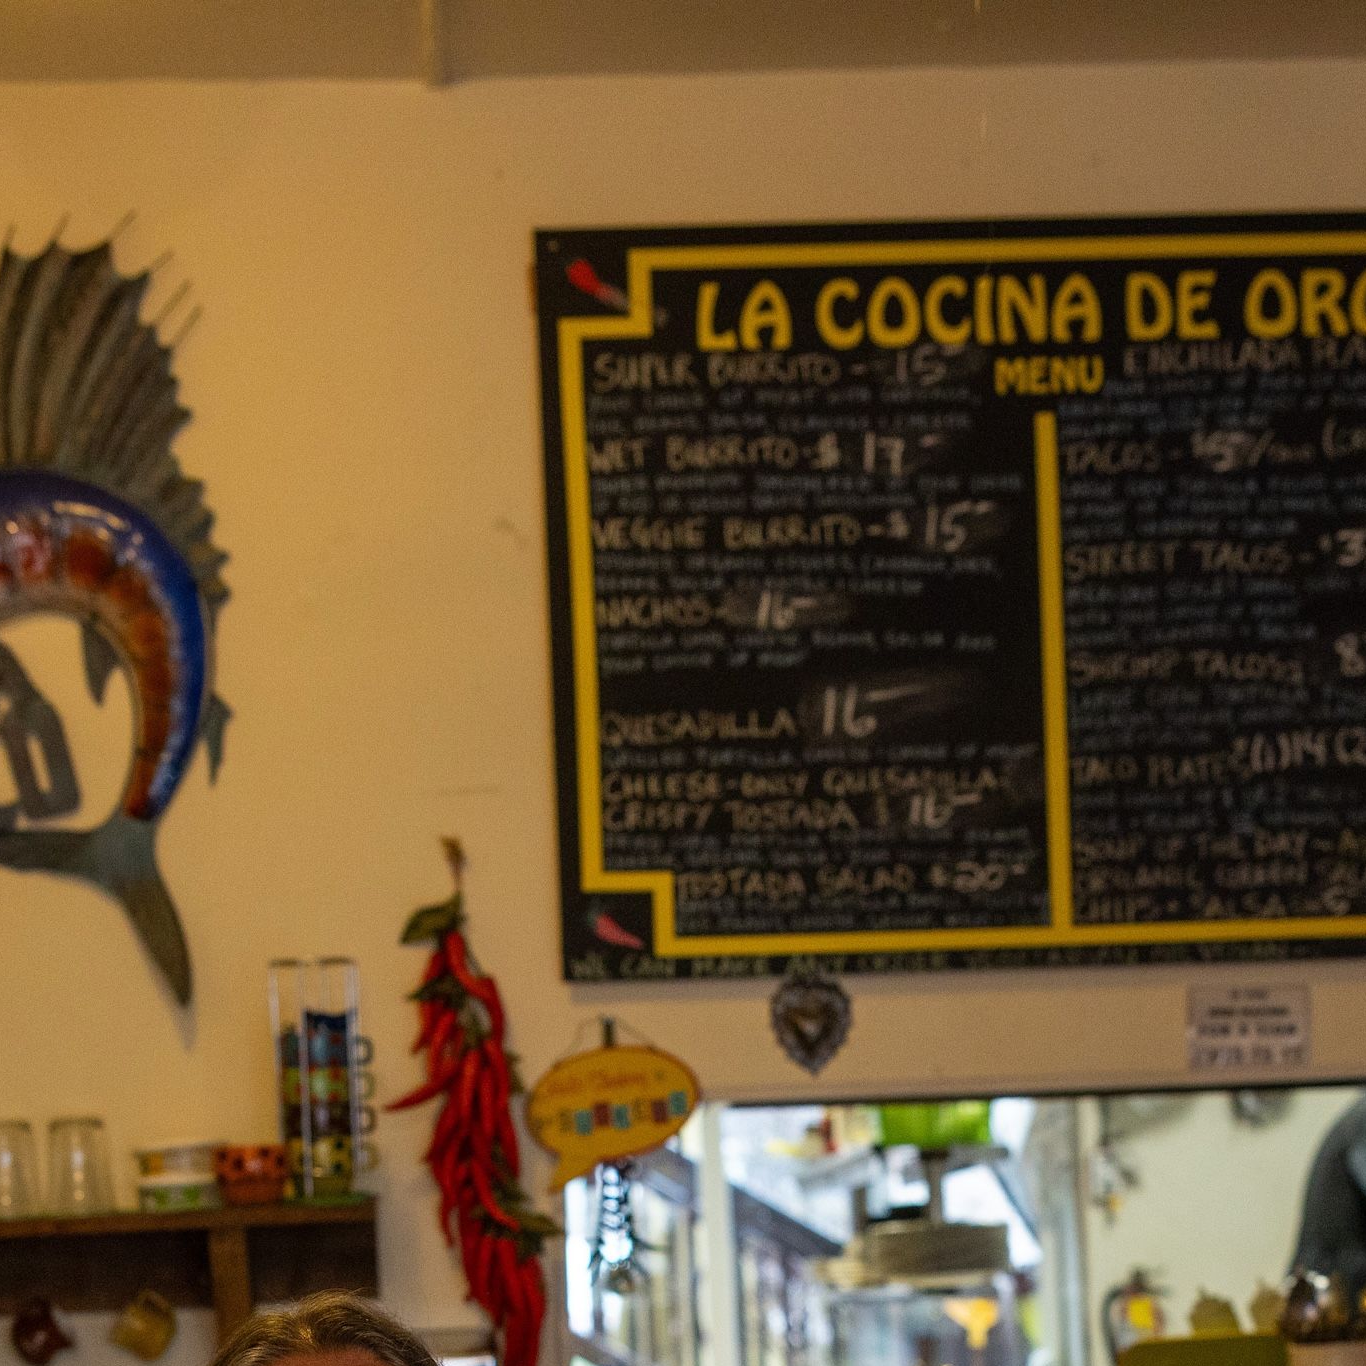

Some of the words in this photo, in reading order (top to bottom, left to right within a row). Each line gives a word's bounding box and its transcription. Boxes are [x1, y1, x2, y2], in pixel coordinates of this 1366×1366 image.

[696, 280, 793, 352] LA
[814, 271, 1105, 350] COCINA
[1124, 269, 1222, 343] DE
[993, 353, 1106, 398] MENU
